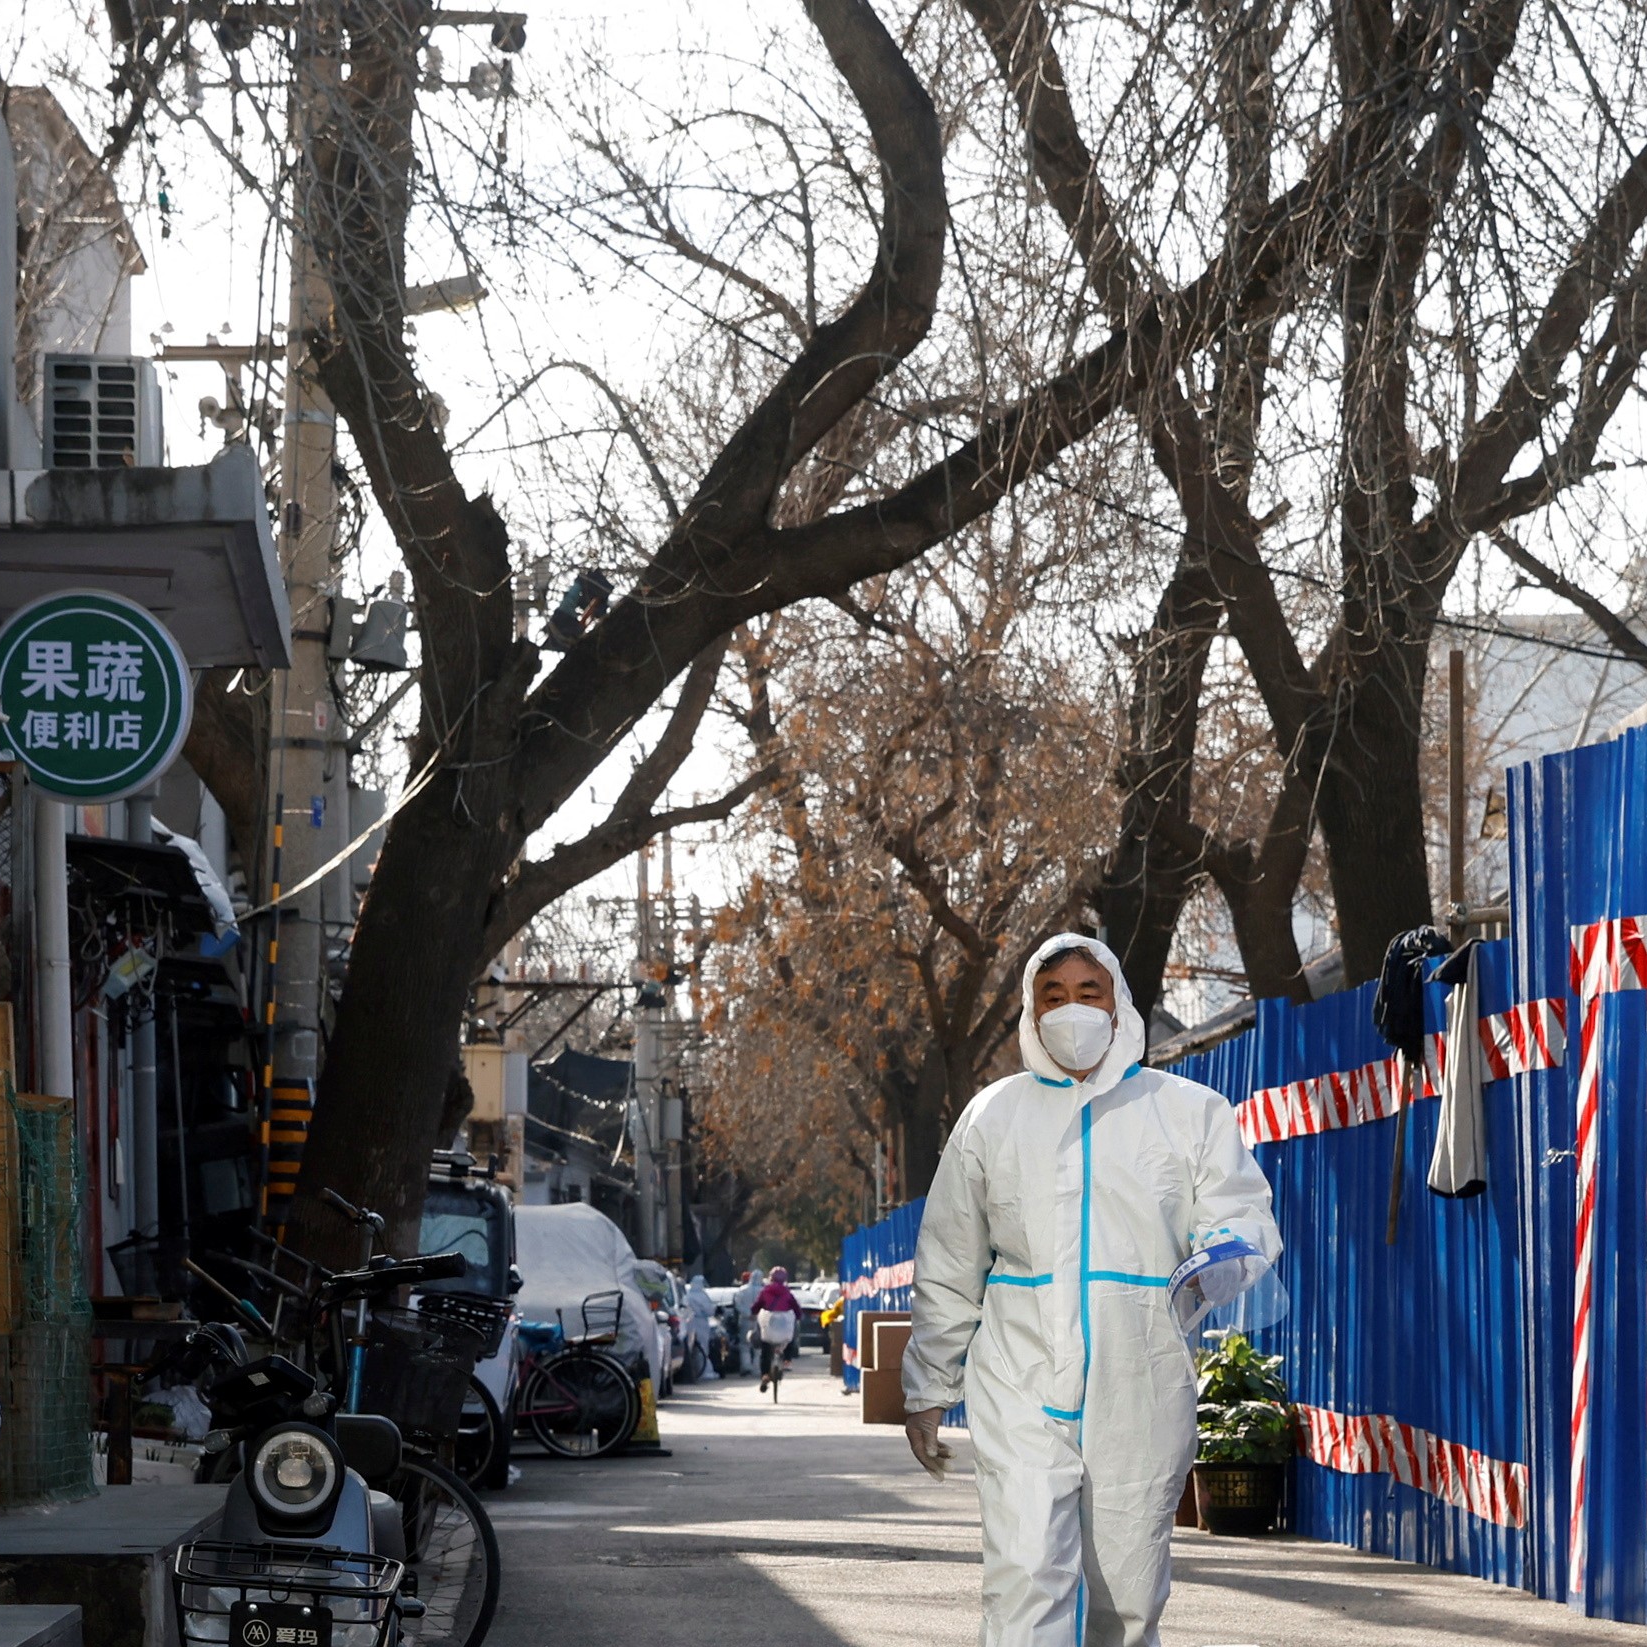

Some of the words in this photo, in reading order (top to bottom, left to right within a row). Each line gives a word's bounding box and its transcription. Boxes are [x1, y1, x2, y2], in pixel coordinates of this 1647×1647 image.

[20, 640, 146, 703] 果蔬
[20, 709, 143, 751] 便利店
[275, 1627, 319, 1646] 爱玛
